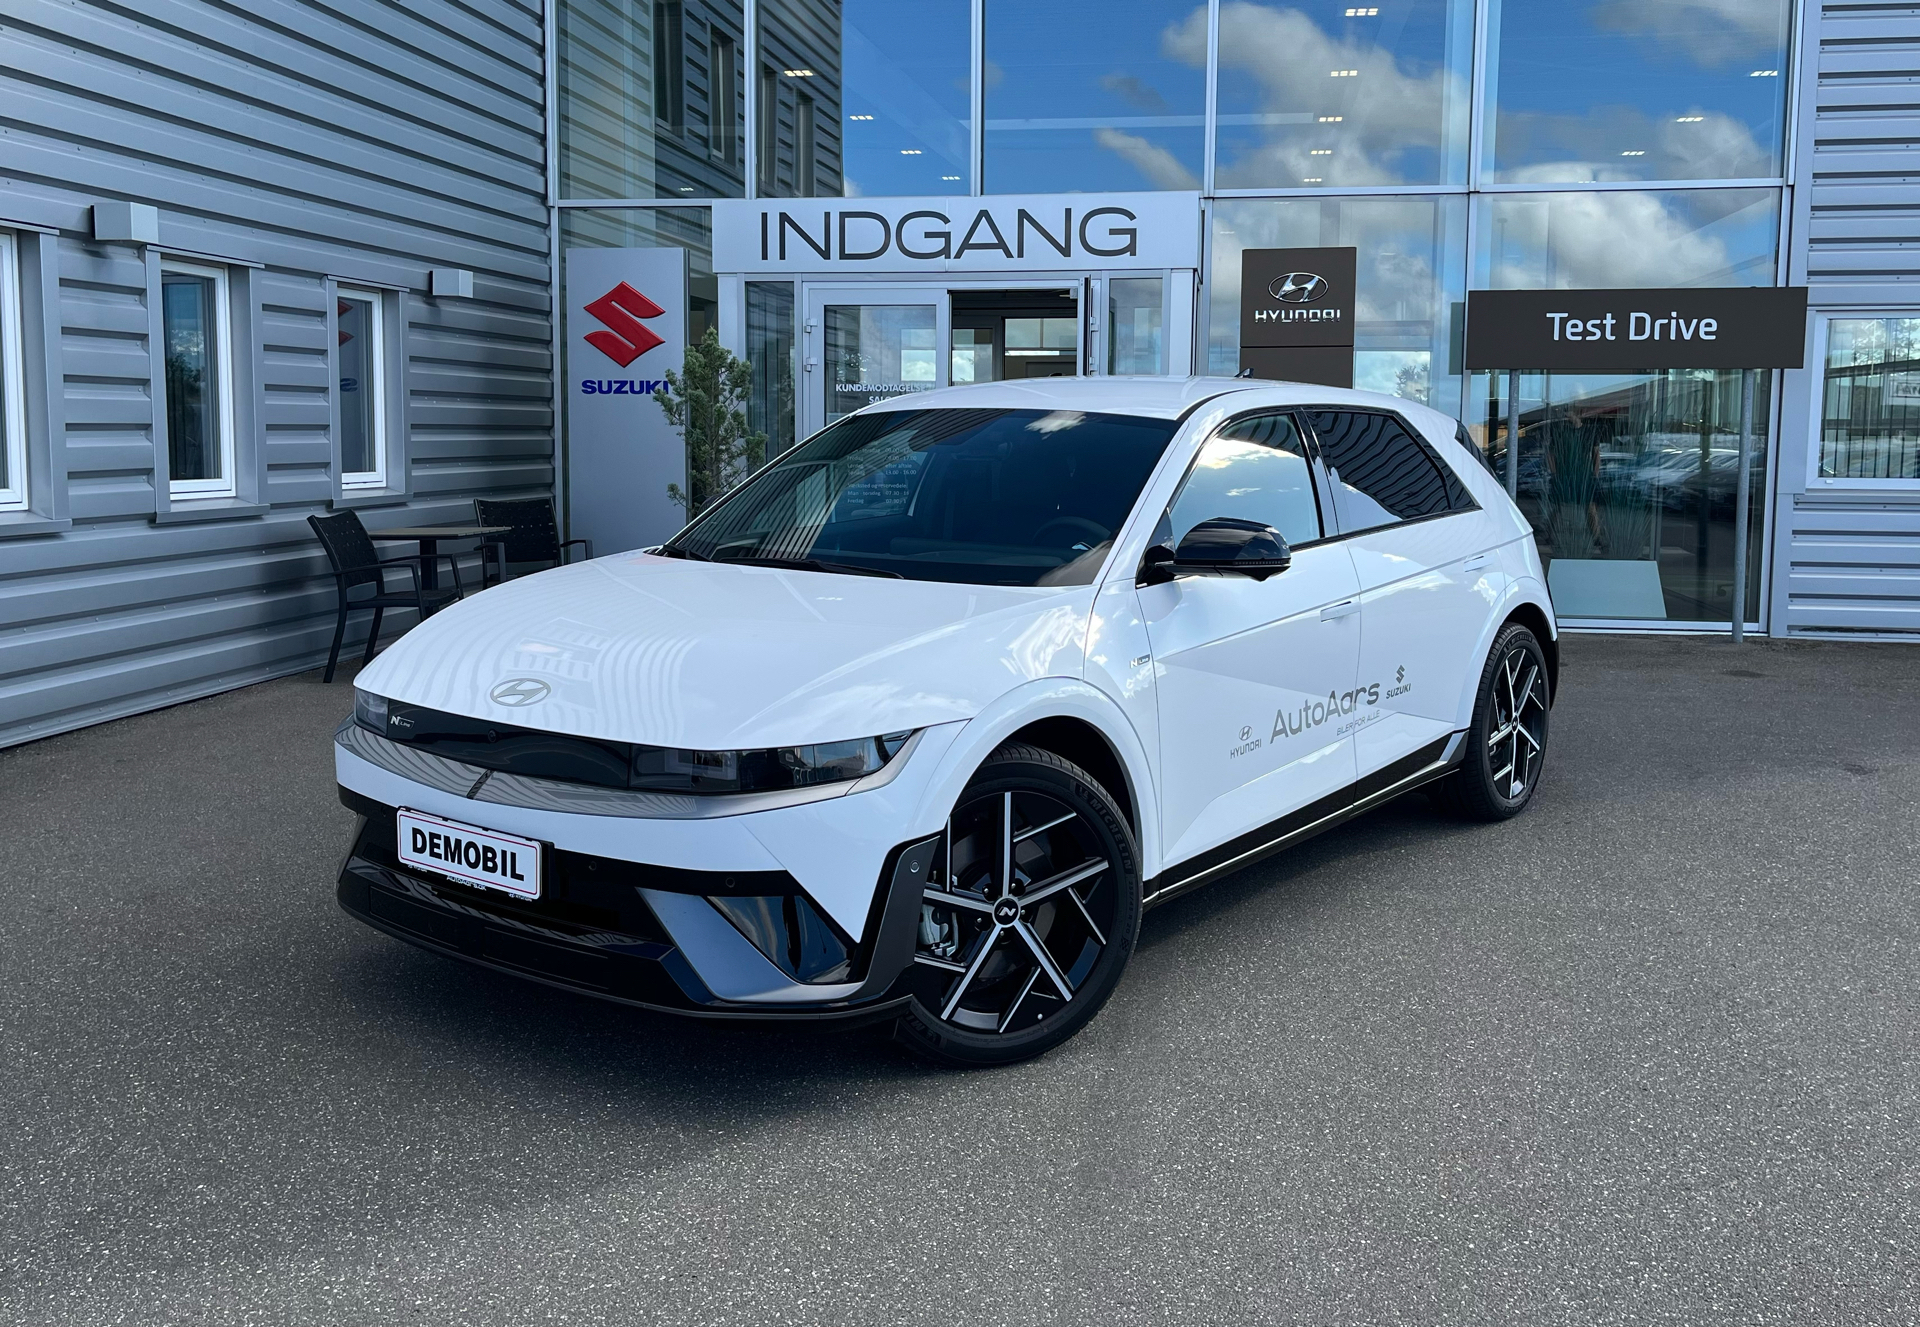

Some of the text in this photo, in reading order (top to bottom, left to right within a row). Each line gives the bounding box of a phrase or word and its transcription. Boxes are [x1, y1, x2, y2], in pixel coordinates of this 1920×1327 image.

[761, 206, 1137, 261] INDGANG
[1254, 309, 1341, 323] HYUNDAI
[1546, 310, 1718, 341] Test Drive
[581, 379, 669, 395] SUZUKI
[1385, 683, 1412, 700] SUZUKI
[1269, 682, 1381, 745] AutoAars
[1366, 709, 1381, 724] ALLE
[1230, 738, 1262, 760] HYUNDAI
[1089, 798, 1132, 870] MICHELIN
[411, 826, 525, 882] DEMOBIL
